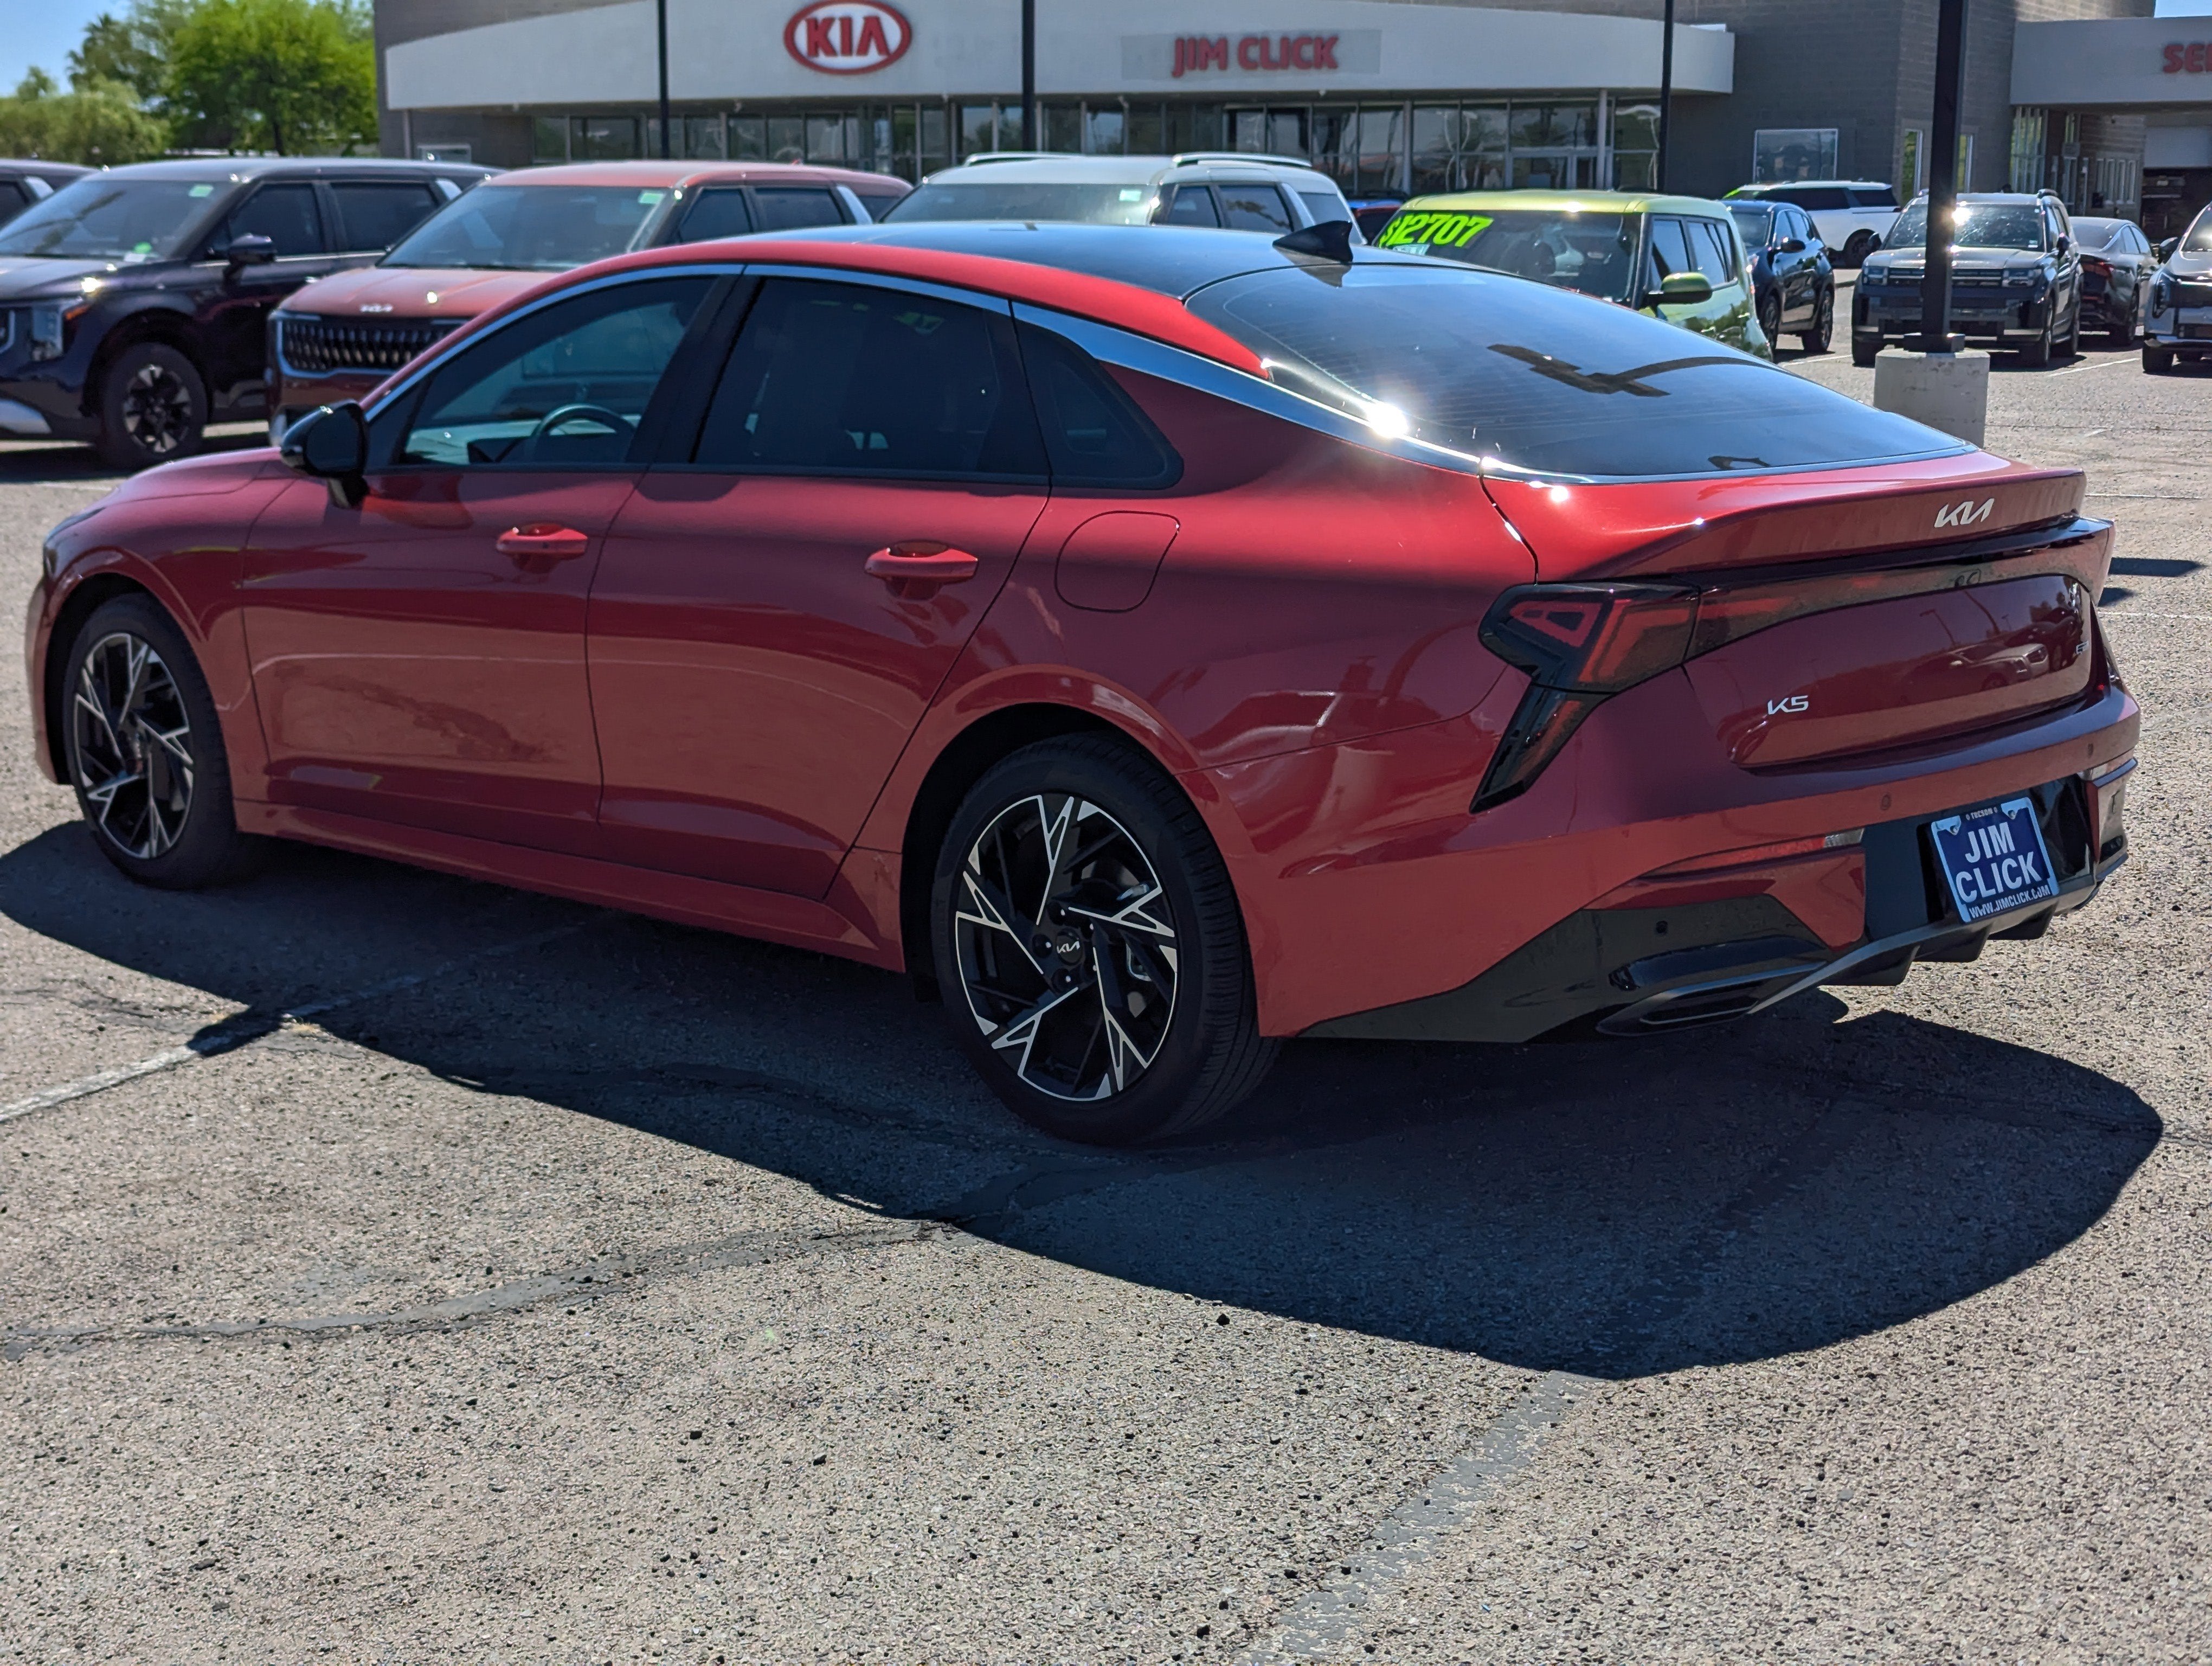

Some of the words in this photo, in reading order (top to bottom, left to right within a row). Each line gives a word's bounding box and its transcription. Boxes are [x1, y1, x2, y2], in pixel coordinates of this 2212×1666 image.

[805, 15, 891, 57] KIA
[1171, 36, 1228, 78] JIM
[1238, 36, 1339, 71] CLICK
[1934, 498, 1995, 528] KIA
[1767, 695, 1809, 715] K5
[1970, 807, 1994, 819] TUCSON
[1965, 821, 2015, 863] JIM
[1956, 851, 2042, 903] CLICK
[1969, 885, 2050, 919] WWW.JIMCLICK.COM
